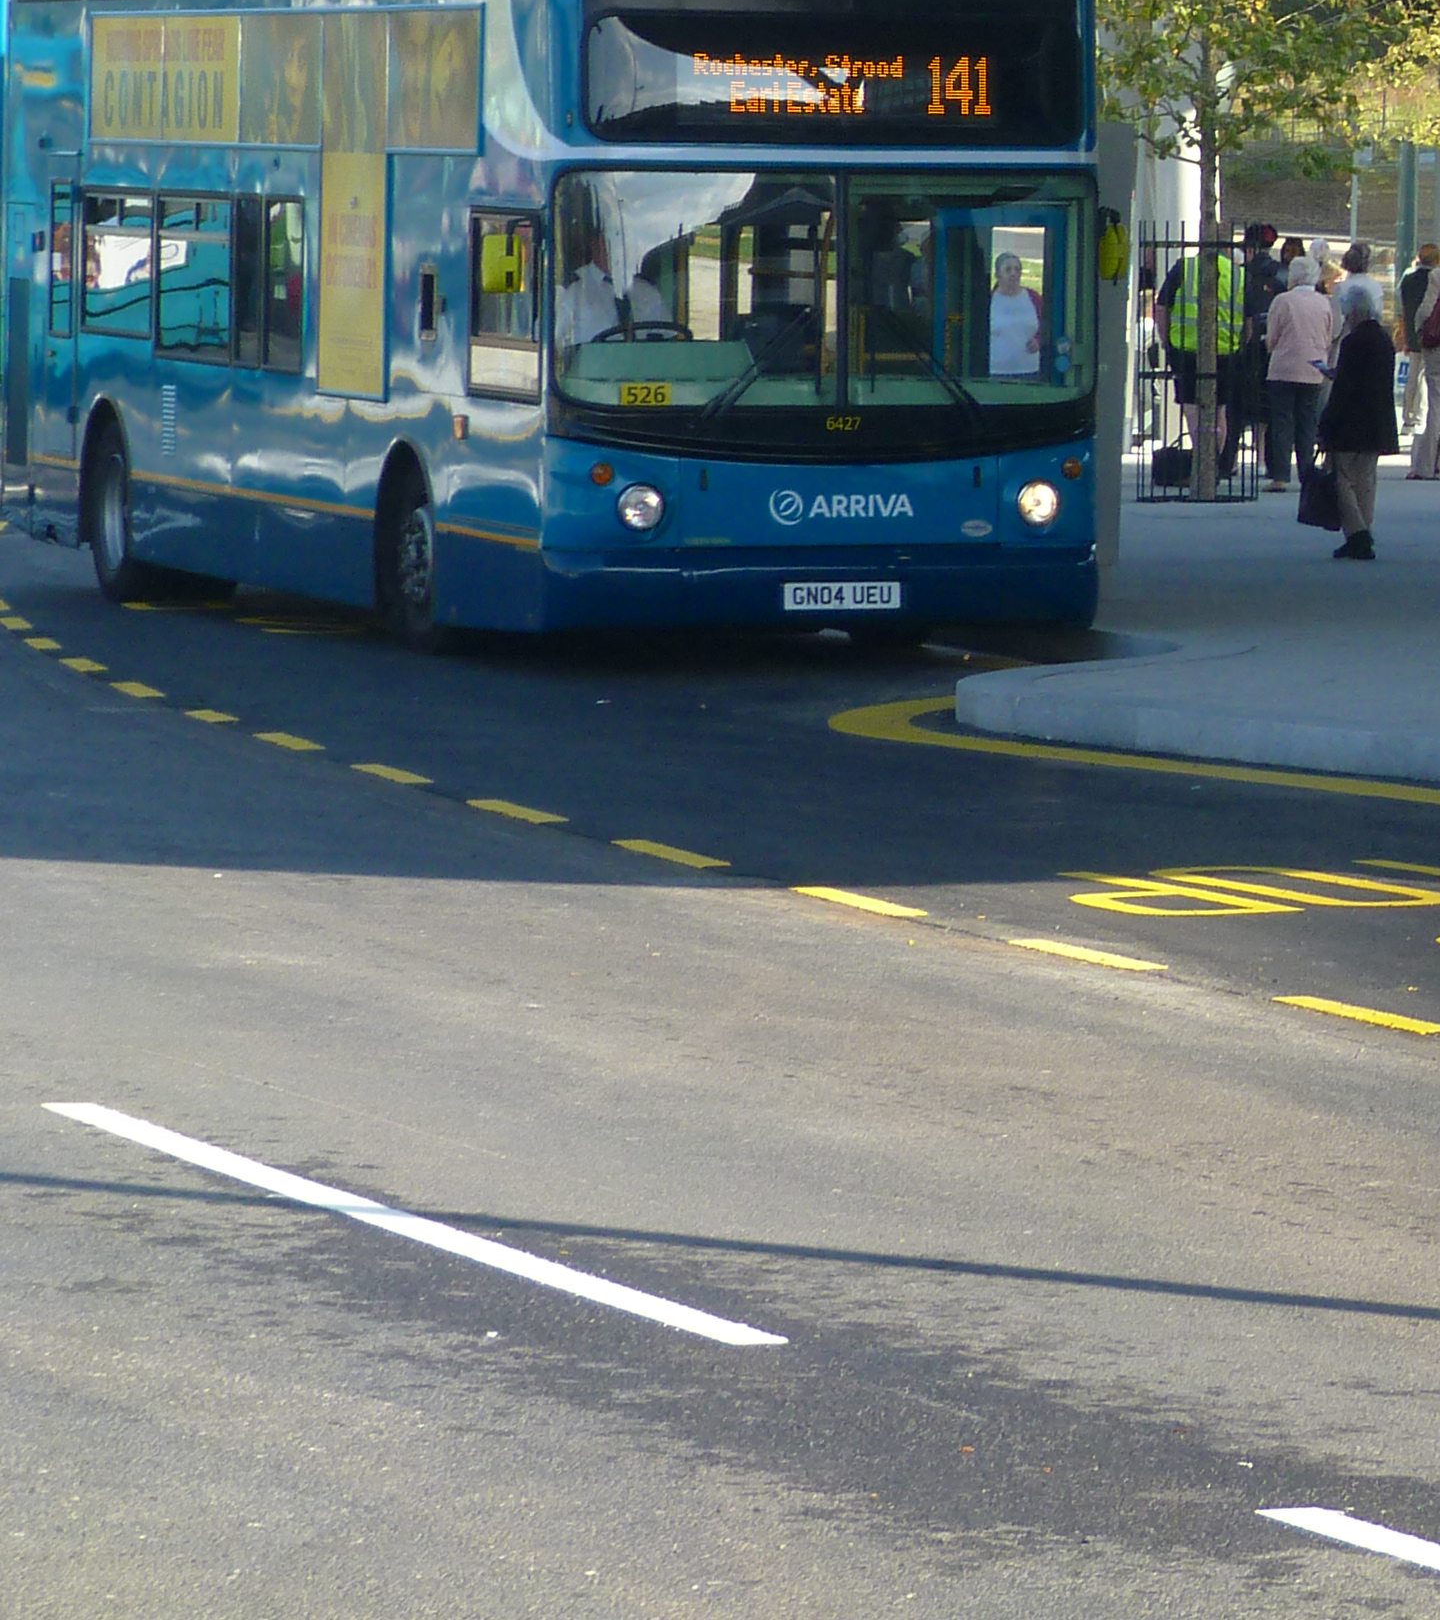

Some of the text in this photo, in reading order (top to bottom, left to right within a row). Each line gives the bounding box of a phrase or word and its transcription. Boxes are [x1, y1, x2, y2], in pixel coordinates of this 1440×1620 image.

[824, 53, 904, 79] Strood
[729, 80, 866, 114] Earl Estate
[927, 55, 992, 116] 141
[103, 69, 224, 130] CONTAGION
[625, 385, 667, 405] 526
[825, 416, 862, 431] 6427
[808, 493, 915, 518] ARRIVA
[792, 585, 893, 606] GN04 UEU
